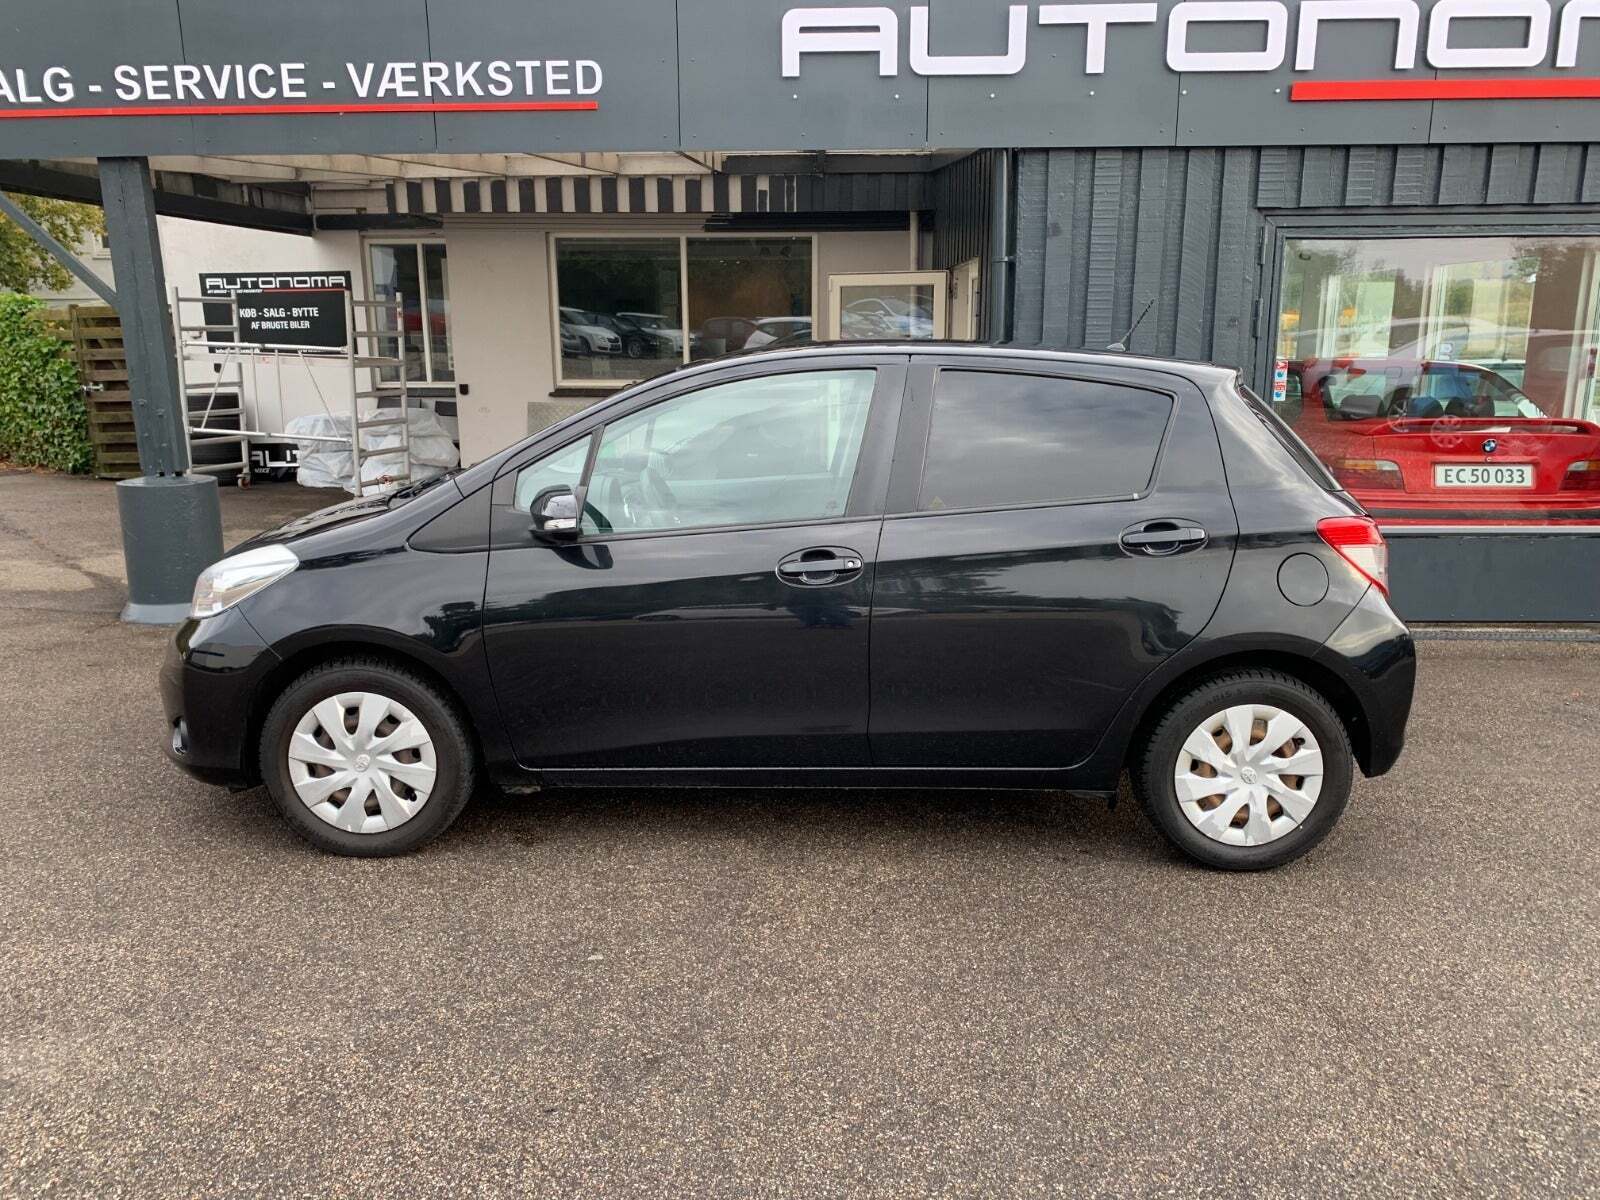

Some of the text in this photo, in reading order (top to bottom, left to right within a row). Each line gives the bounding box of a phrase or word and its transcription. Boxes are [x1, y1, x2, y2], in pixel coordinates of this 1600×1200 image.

[114, 62, 307, 101] SERVICE
[346, 59, 603, 98] VÆRKSTED
[205, 276, 346, 290] AUTONOMA
[239, 308, 257, 318] KØB
[263, 307, 286, 318] SALG
[292, 307, 319, 317] BYTTE
[251, 320, 310, 330] AF BRUGTE BILER
[1444, 468, 1525, 484] EC 50 033
